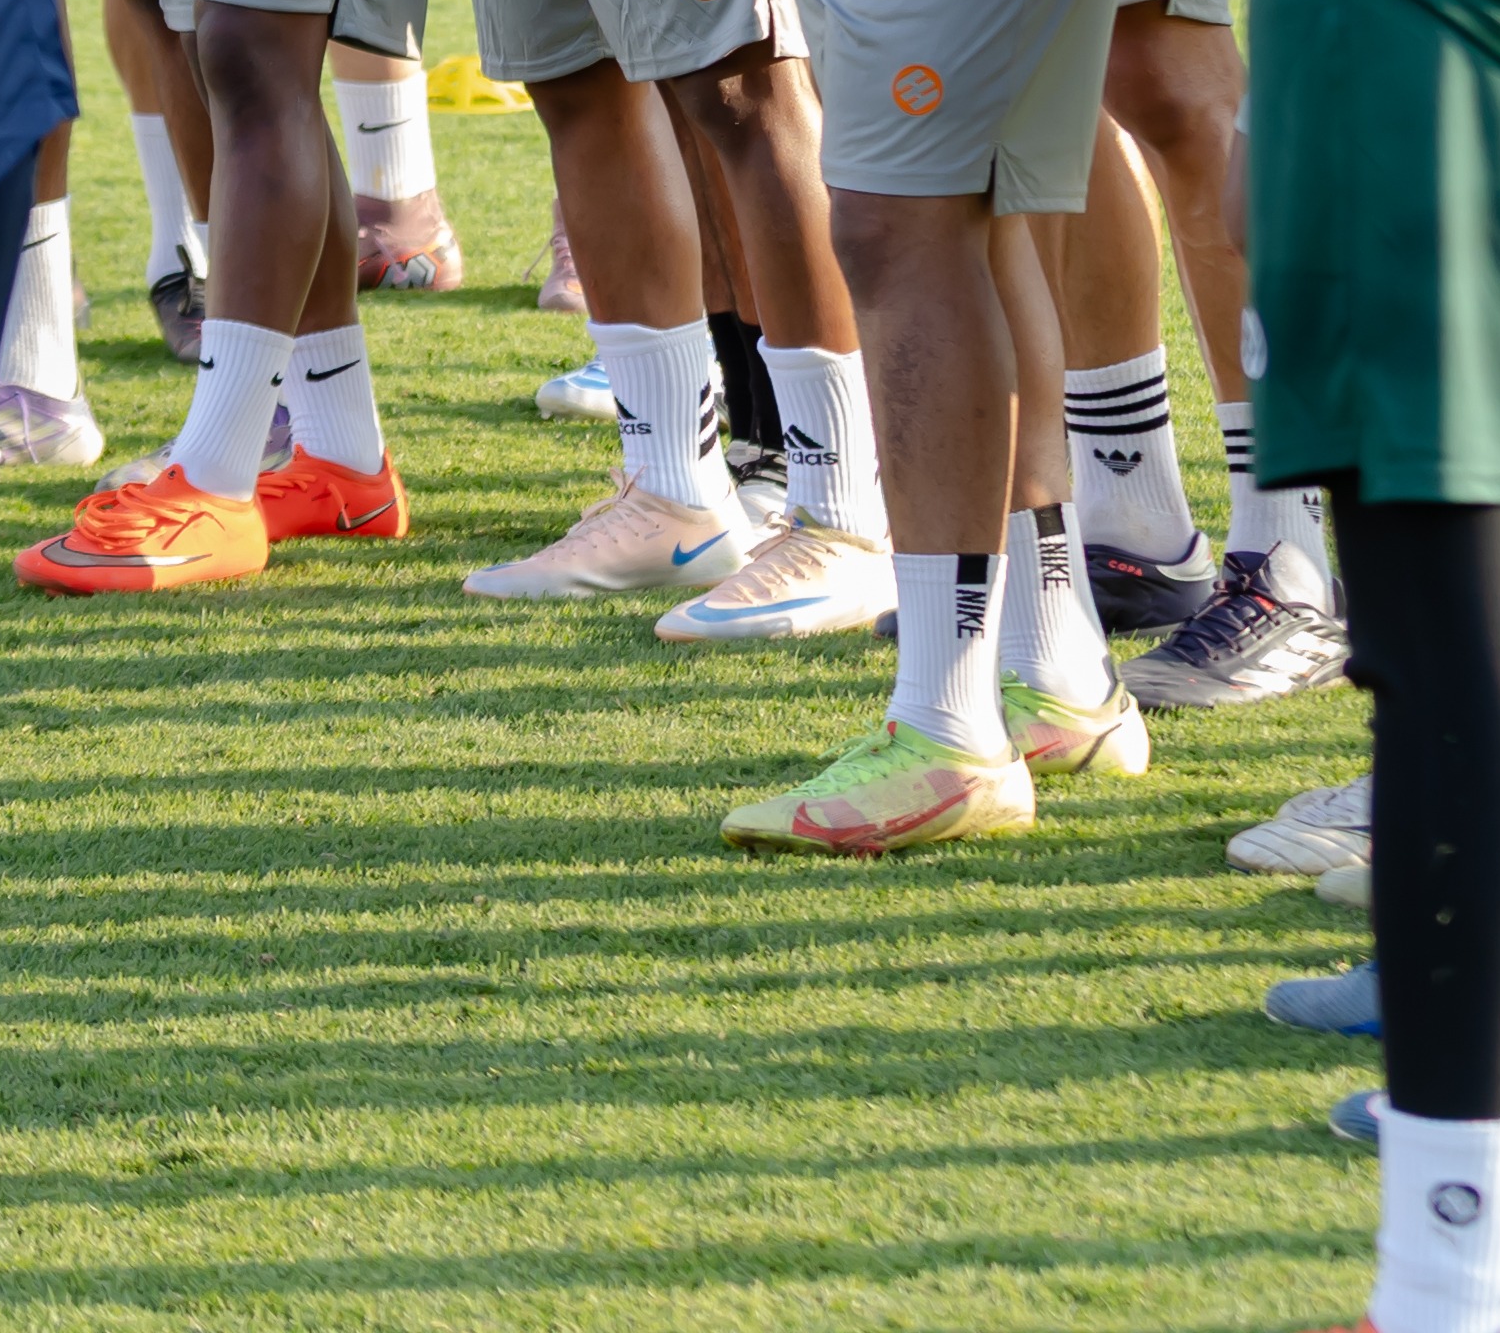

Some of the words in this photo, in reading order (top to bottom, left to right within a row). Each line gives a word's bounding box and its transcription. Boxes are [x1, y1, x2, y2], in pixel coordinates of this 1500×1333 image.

[1039, 543, 1071, 590] NIKE
[1107, 559, 1144, 577] COPA
[956, 589, 987, 639] NIKE
